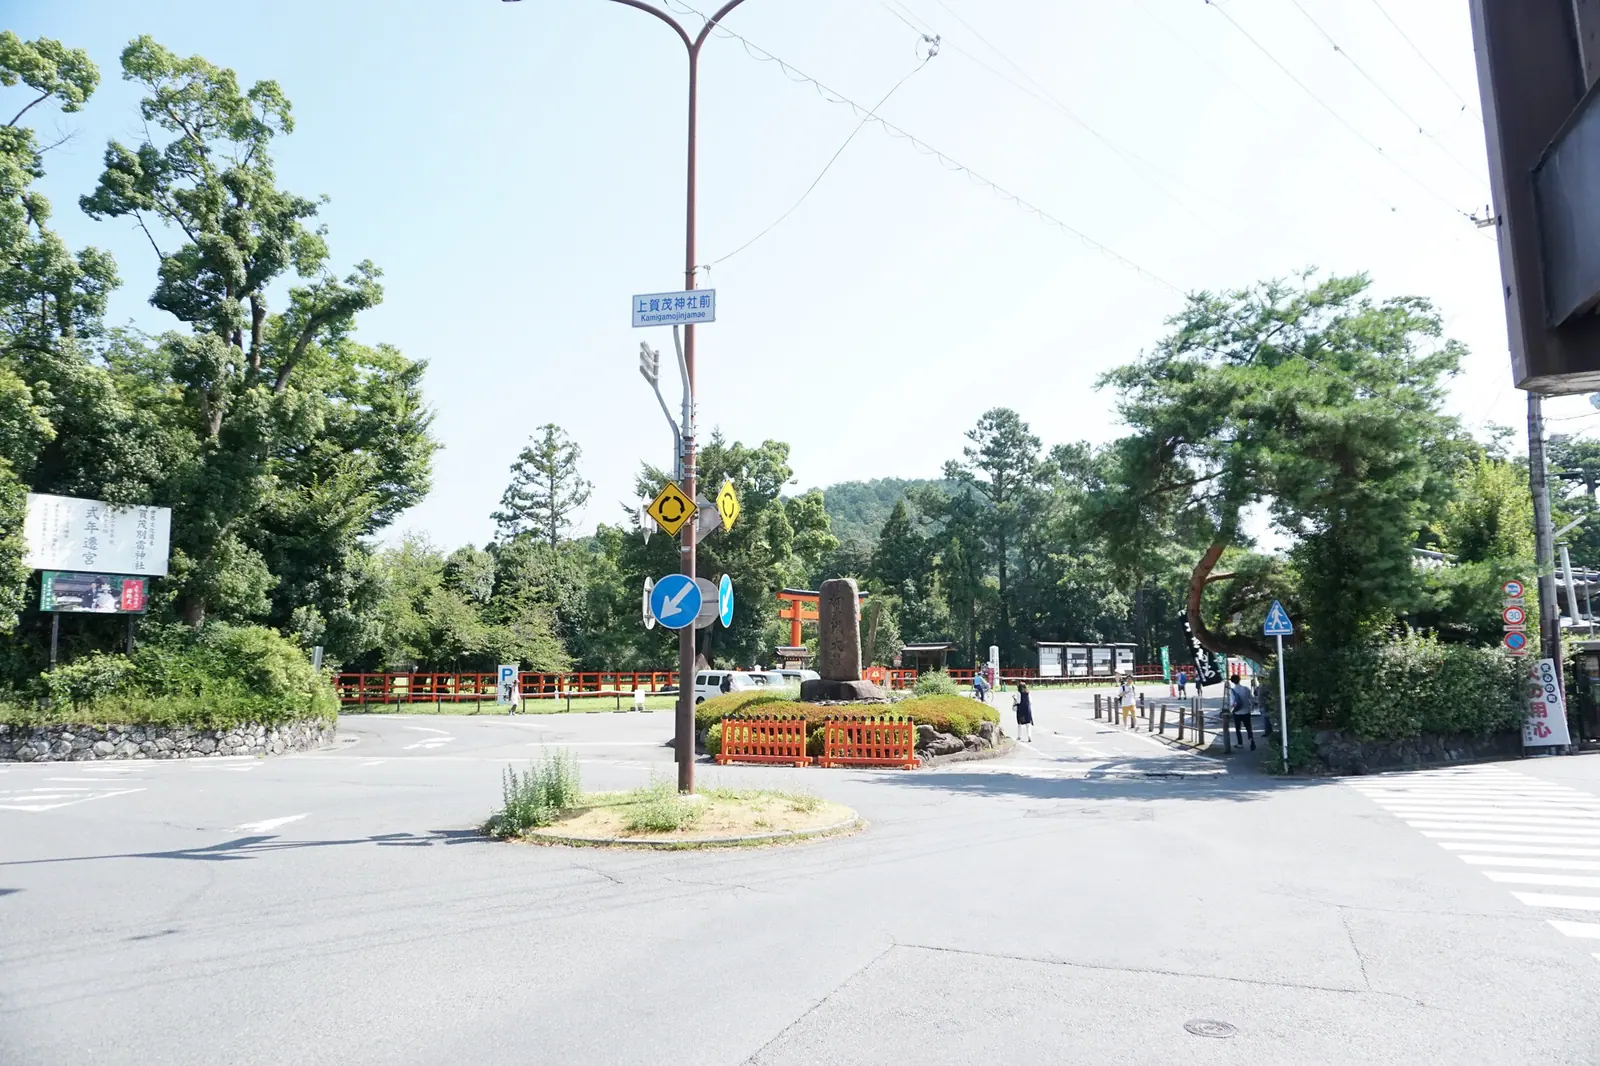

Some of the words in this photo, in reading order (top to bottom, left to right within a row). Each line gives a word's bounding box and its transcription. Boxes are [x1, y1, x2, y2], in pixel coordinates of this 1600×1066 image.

[637, 295, 711, 313] 上賀茂神社前
[640, 311, 706, 322] Kamigamojinjamae
[82, 506, 100, 565] 式年遷宮
[1508, 611, 1520, 620] 30
[501, 668, 513, 681] P
